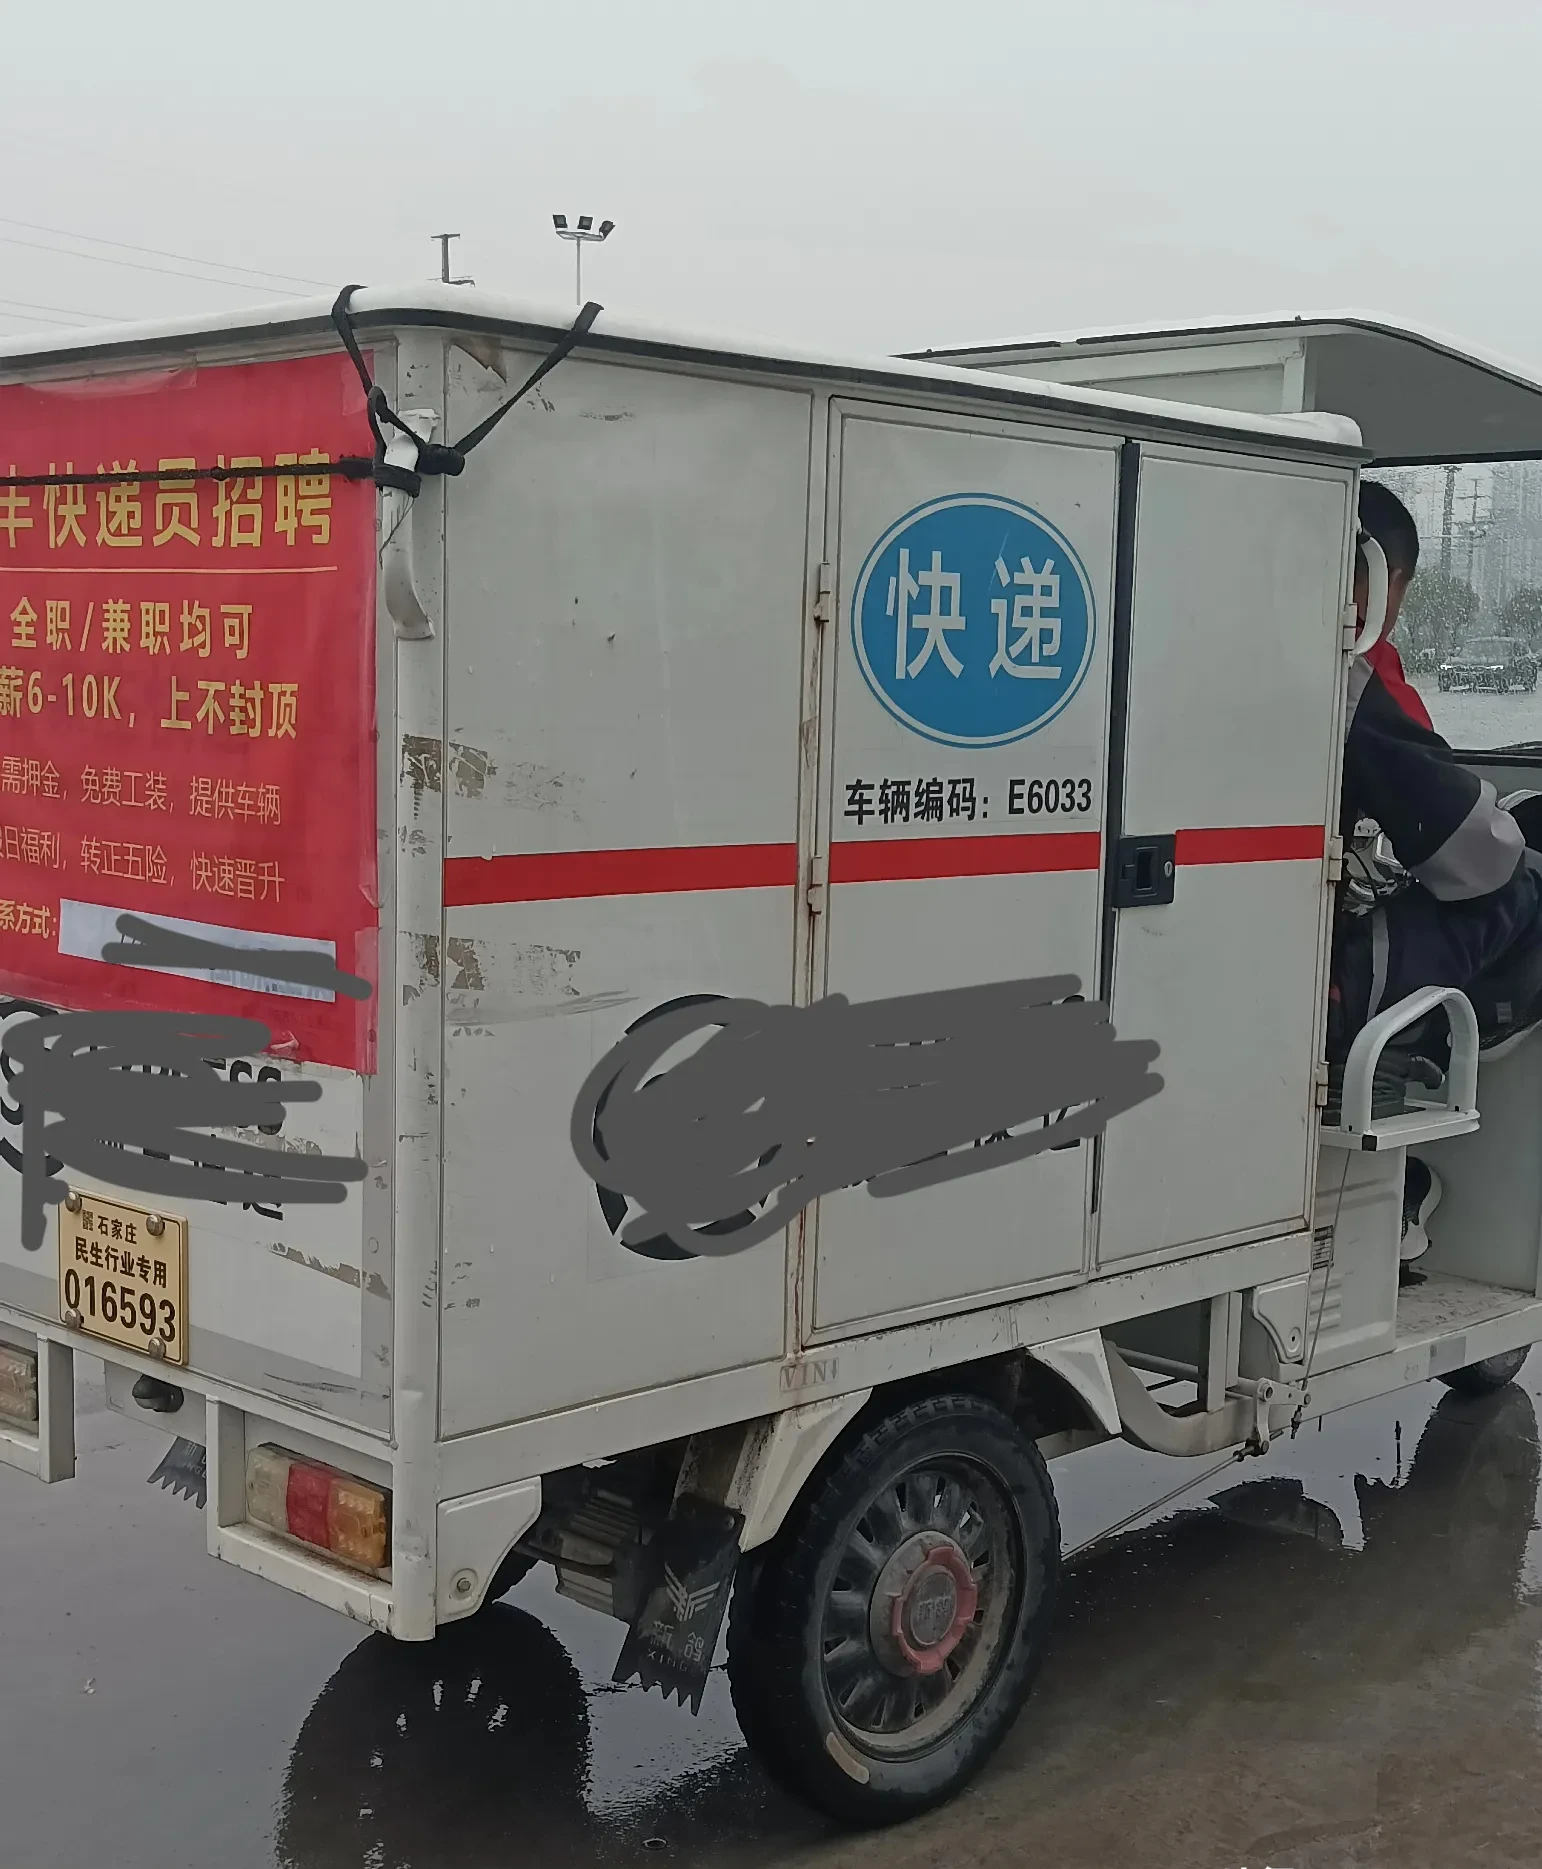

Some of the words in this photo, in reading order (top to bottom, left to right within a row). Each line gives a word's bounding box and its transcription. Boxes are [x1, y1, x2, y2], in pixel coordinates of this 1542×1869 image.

[10, 596, 252, 659] 全职/兼职均可
[886, 547, 1062, 680] 快递
[0, 825, 285, 902] 日福利，转正五险，快速晋升
[98, 1215, 137, 1244] 石家庄
[75, 1236, 167, 1288] 民生行业专用
[65, 1269, 176, 1342] 016593
[783, 1360, 827, 1388] VIN
